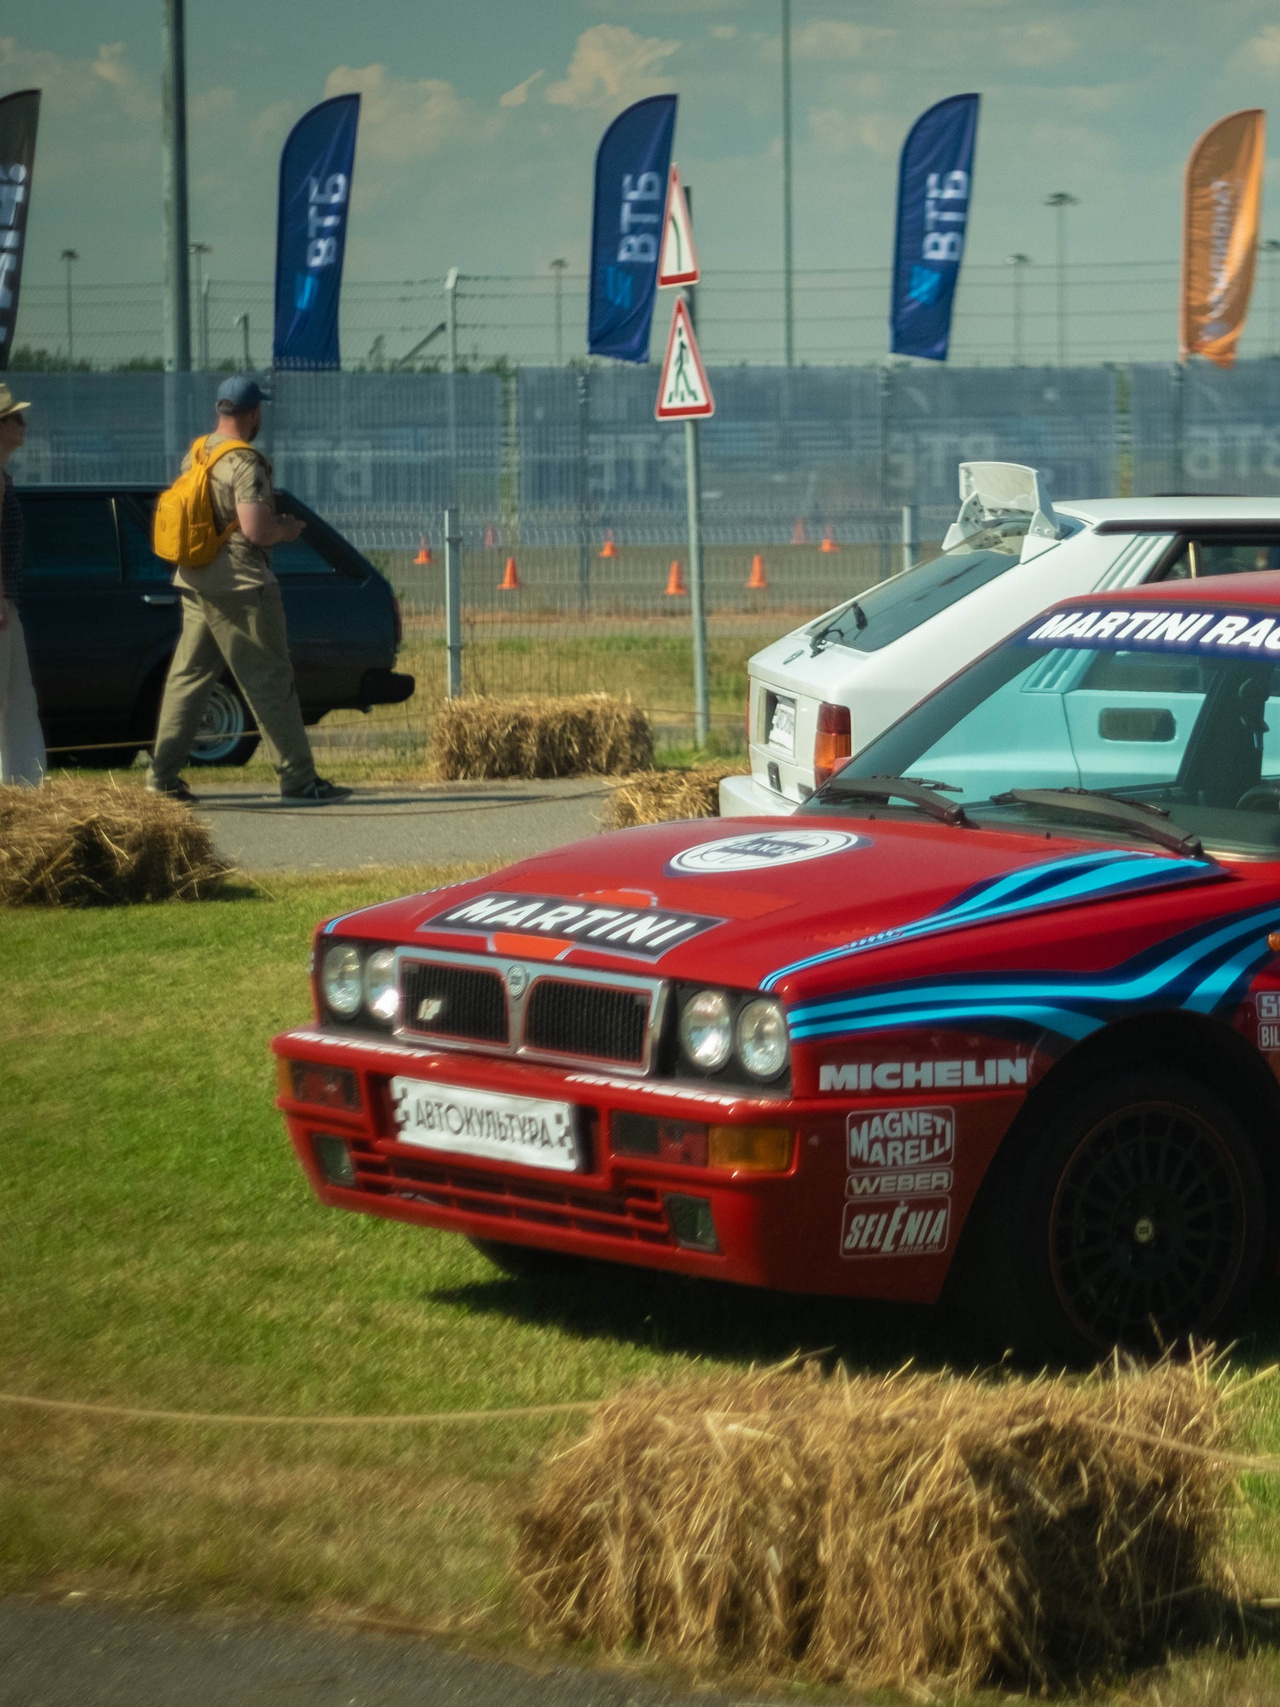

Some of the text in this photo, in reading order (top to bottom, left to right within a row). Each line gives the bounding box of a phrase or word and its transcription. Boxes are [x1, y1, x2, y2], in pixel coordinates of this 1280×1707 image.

[307, 172, 347, 268] ВТБ
[617, 169, 664, 263] ВТБ
[922, 169, 969, 261] ВТБ
[1028, 610, 1204, 642] MARTINI
[446, 898, 700, 949] MARTINI
[819, 1058, 1028, 1091] MICHELIN
[416, 1098, 554, 1148] АВТОКУЛЬТУРА
[851, 1111, 952, 1147] MAGNETI
[851, 1135, 952, 1167] MARELLI
[851, 1171, 949, 1195] WEBER
